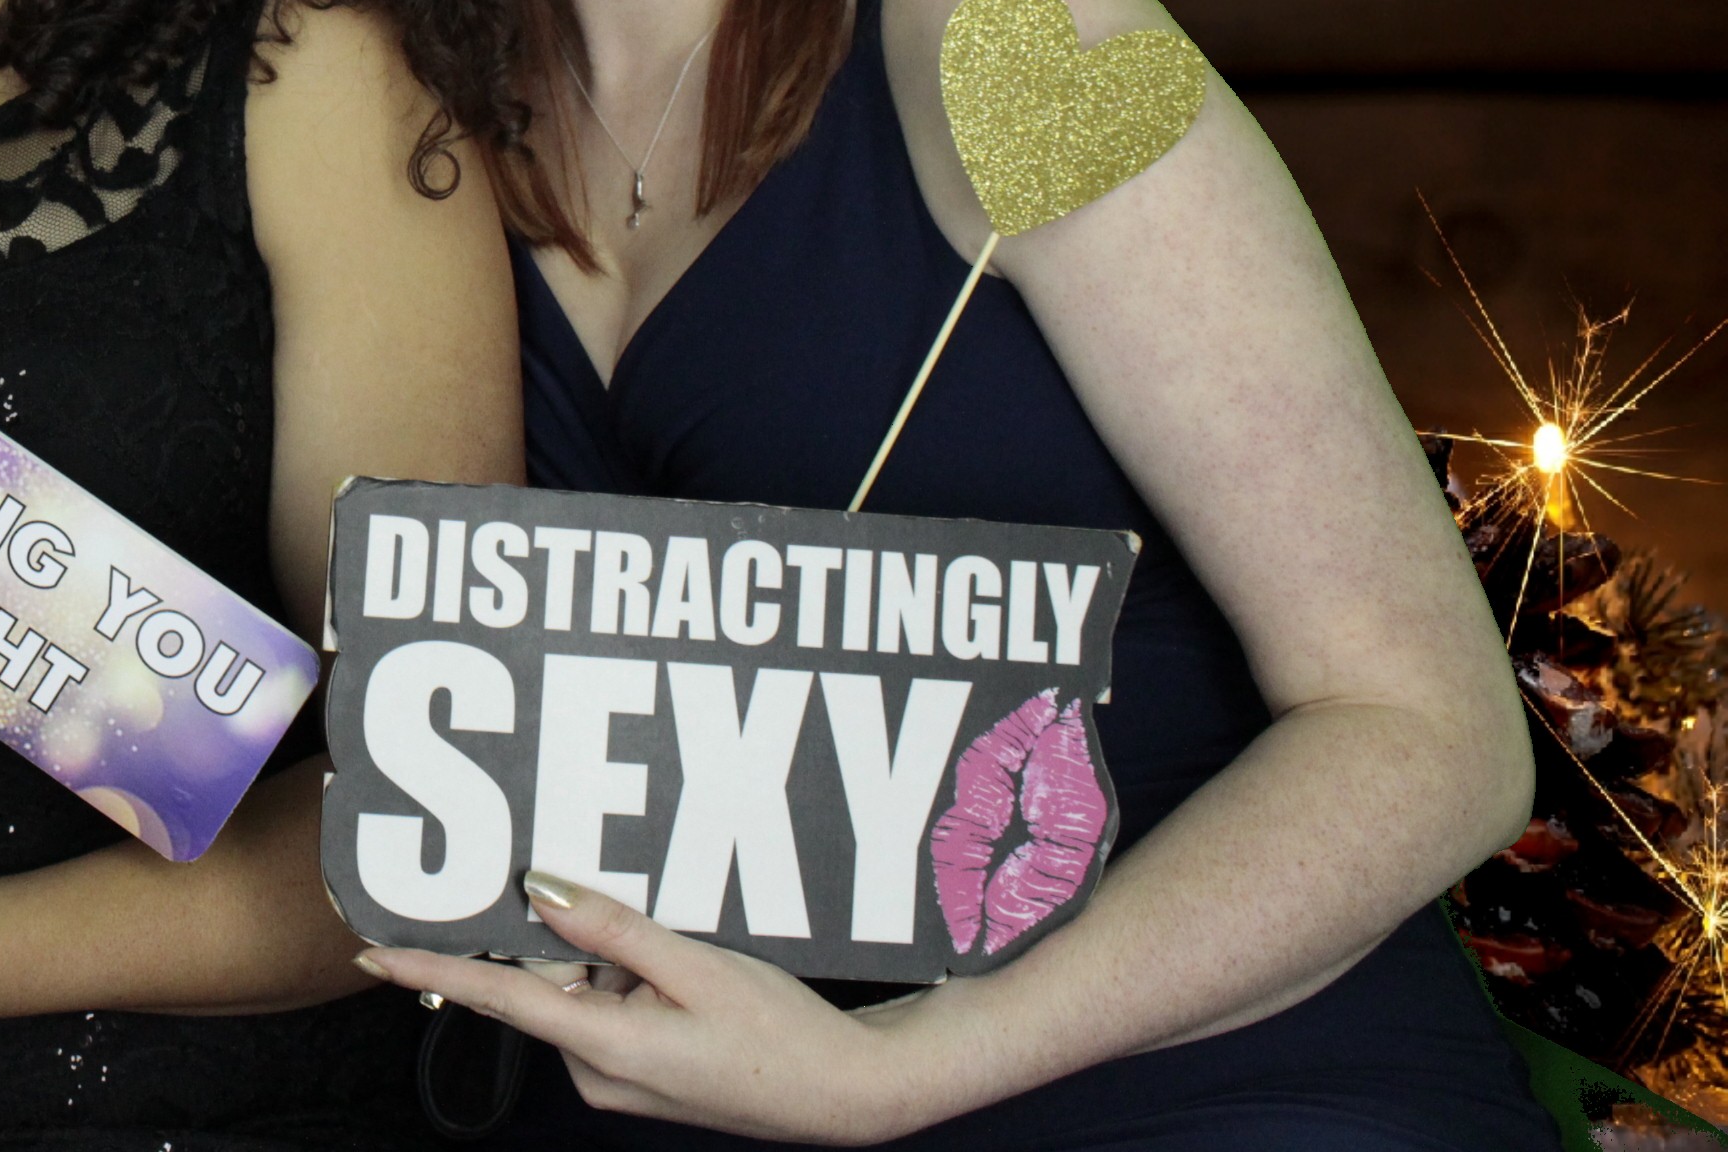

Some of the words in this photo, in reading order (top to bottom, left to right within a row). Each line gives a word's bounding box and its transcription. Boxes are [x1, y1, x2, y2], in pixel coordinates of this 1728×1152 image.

[93, 565, 265, 716] YOU
[362, 513, 1101, 666] DISTRACTINGLY
[356, 640, 973, 945] SEXY
